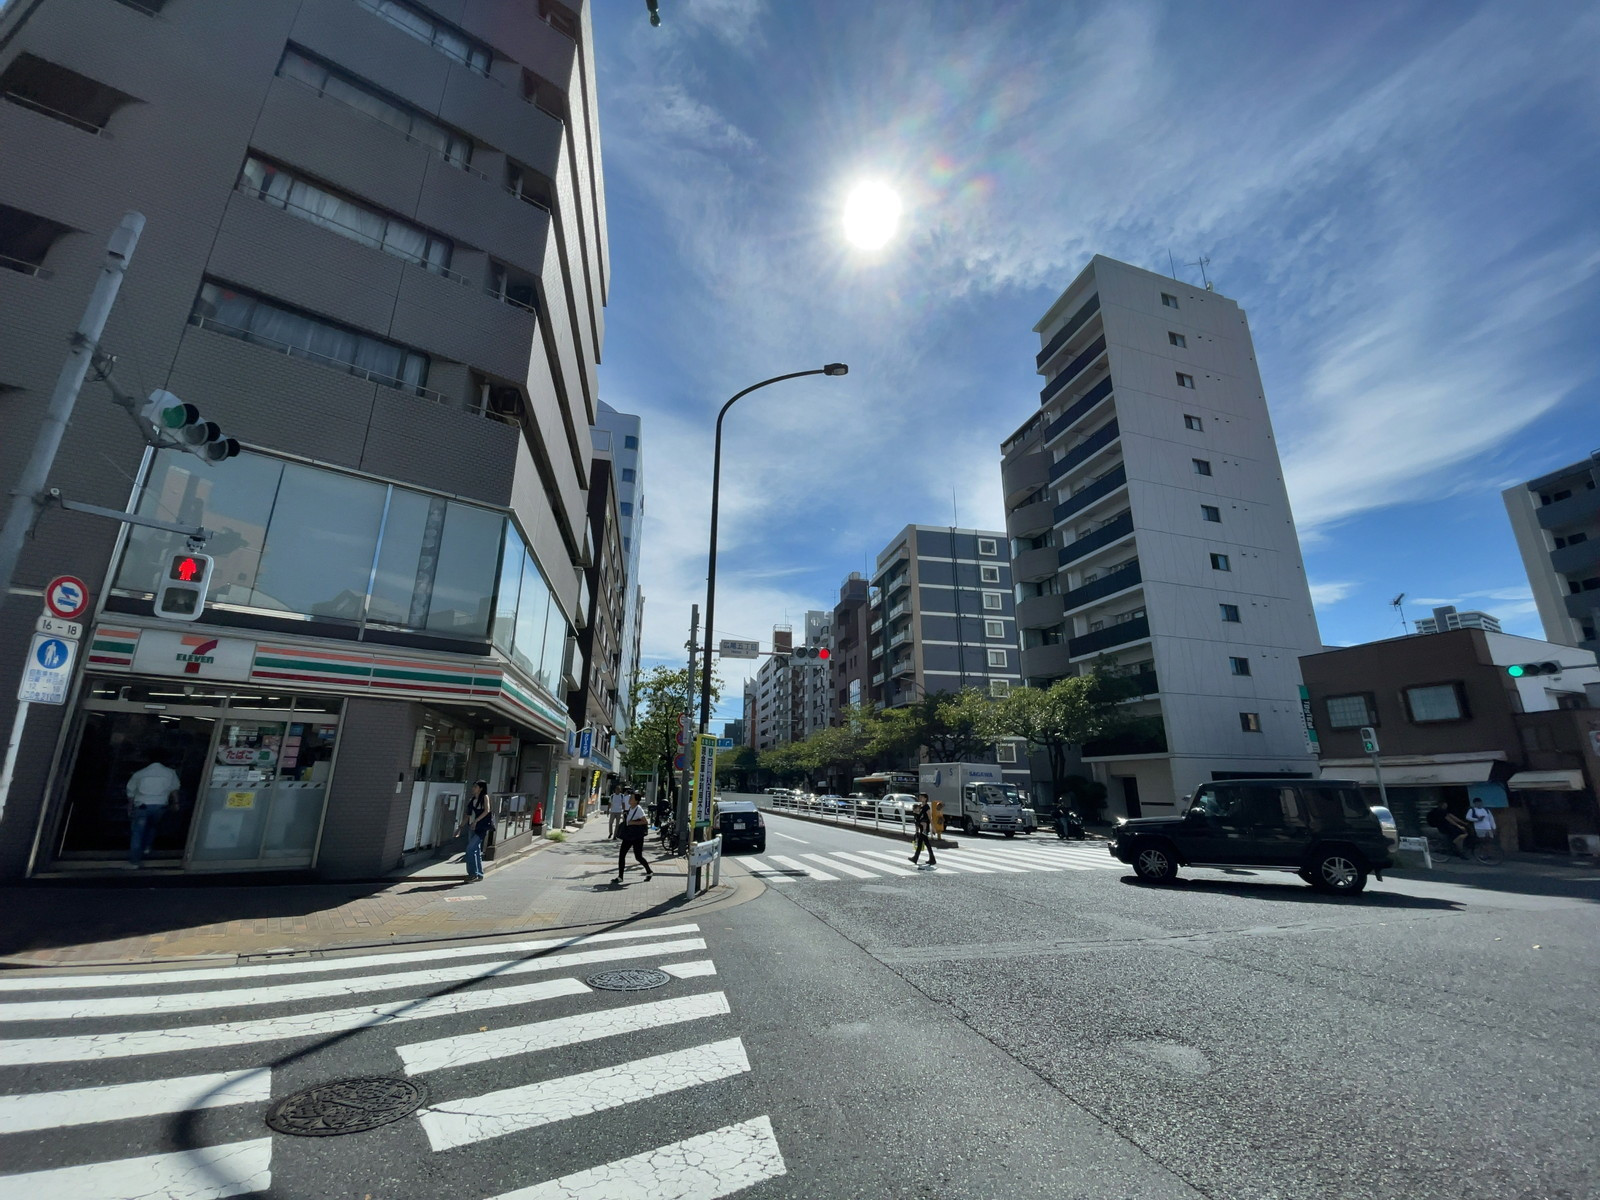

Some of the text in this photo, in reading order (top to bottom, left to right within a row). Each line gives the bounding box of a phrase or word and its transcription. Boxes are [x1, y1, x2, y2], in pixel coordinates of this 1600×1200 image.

[42, 619, 52, 630] 16
[67, 624, 77, 635] 18
[226, 750, 253, 760] たばこ
